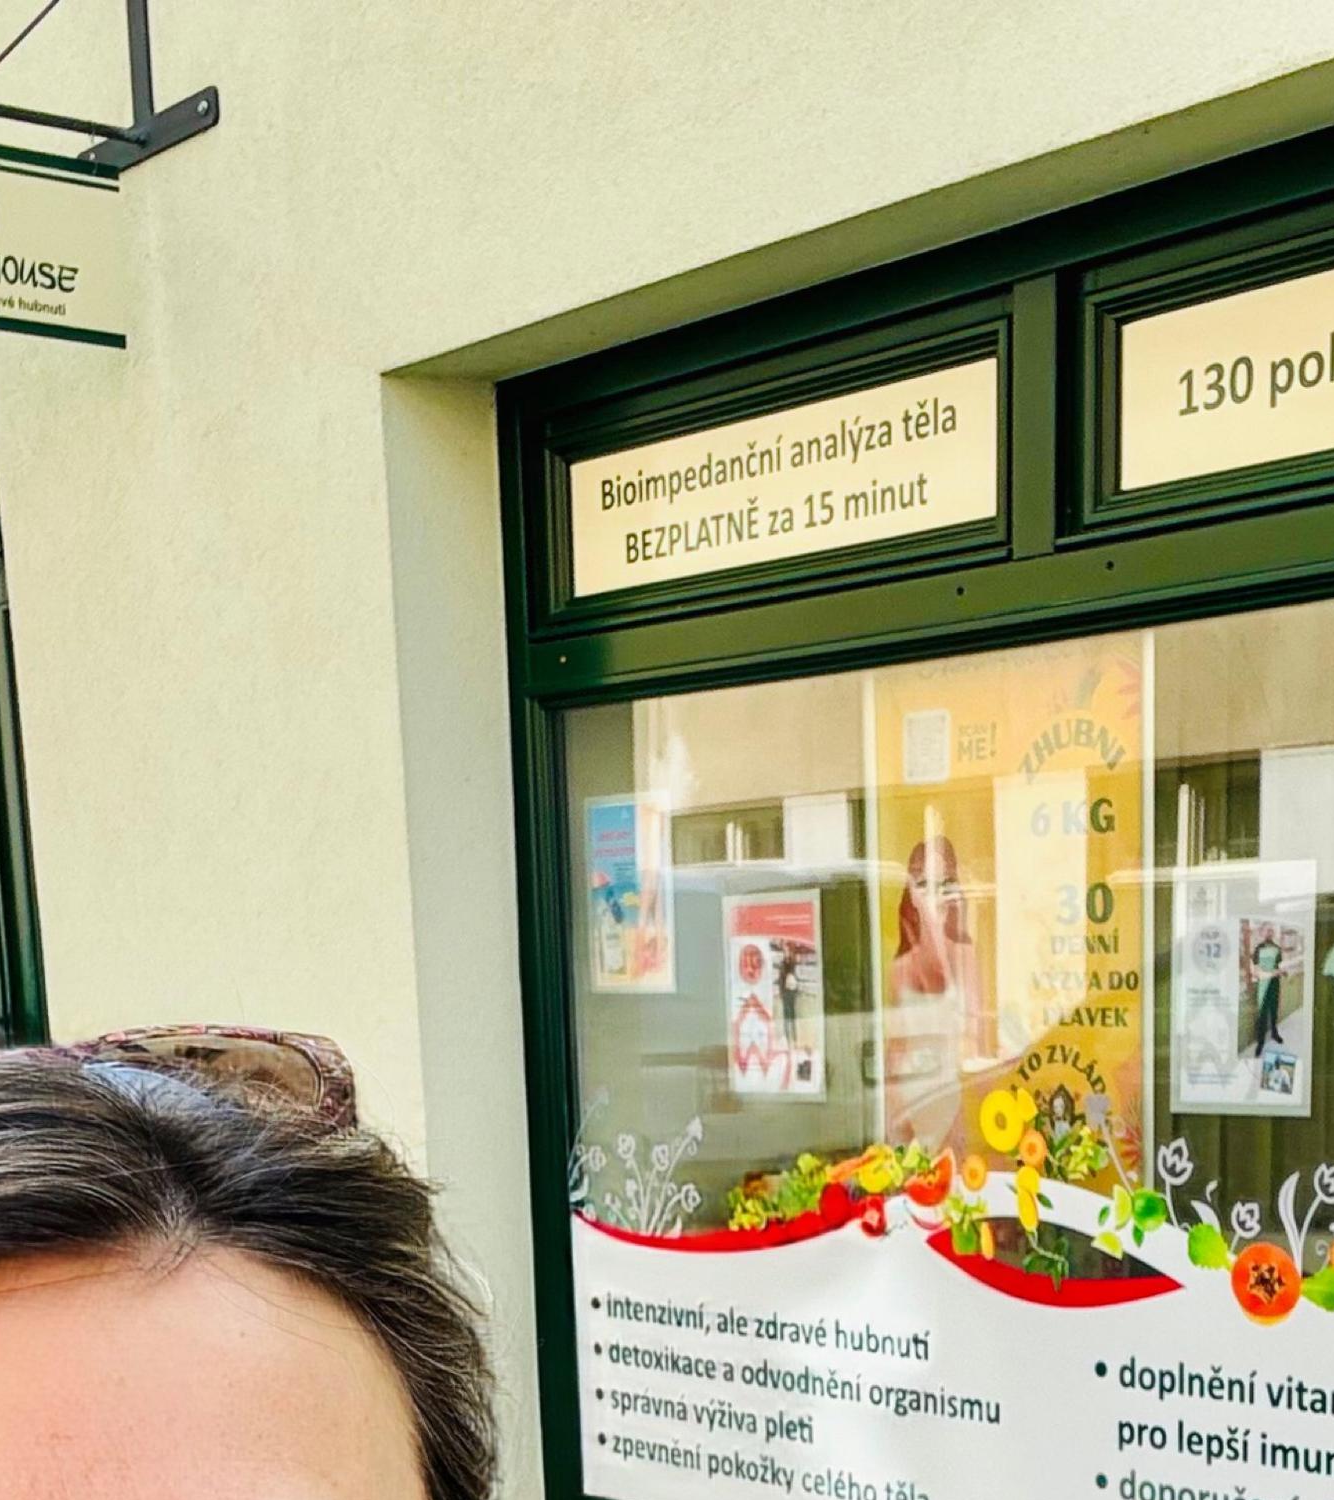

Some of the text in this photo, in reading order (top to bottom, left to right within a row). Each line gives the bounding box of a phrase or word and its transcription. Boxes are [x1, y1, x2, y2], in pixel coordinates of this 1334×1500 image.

[1178, 354, 1255, 417] 130
[601, 397, 958, 512] Bioimpedanční analýza těla
[625, 472, 928, 565] BEZPLATNĚ za 15 minut
[1030, 798, 1116, 838] 6 KG
[1056, 881, 1115, 926] 30
[1108, 969, 1139, 992] DO
[606, 1292, 931, 1361] intenzivní, ale zdravé hubnutí
[608, 1342, 1001, 1425] detoxikace a odvodnění organismu
[1119, 1355, 1257, 1405] doplnění
[611, 1386, 688, 1422] správná
[693, 1394, 758, 1435] výživa
[612, 1433, 702, 1471] zpevnění
[708, 1445, 795, 1494] pokožky
[1117, 1415, 1168, 1453] pro
[1177, 1420, 1252, 1466] lepší
